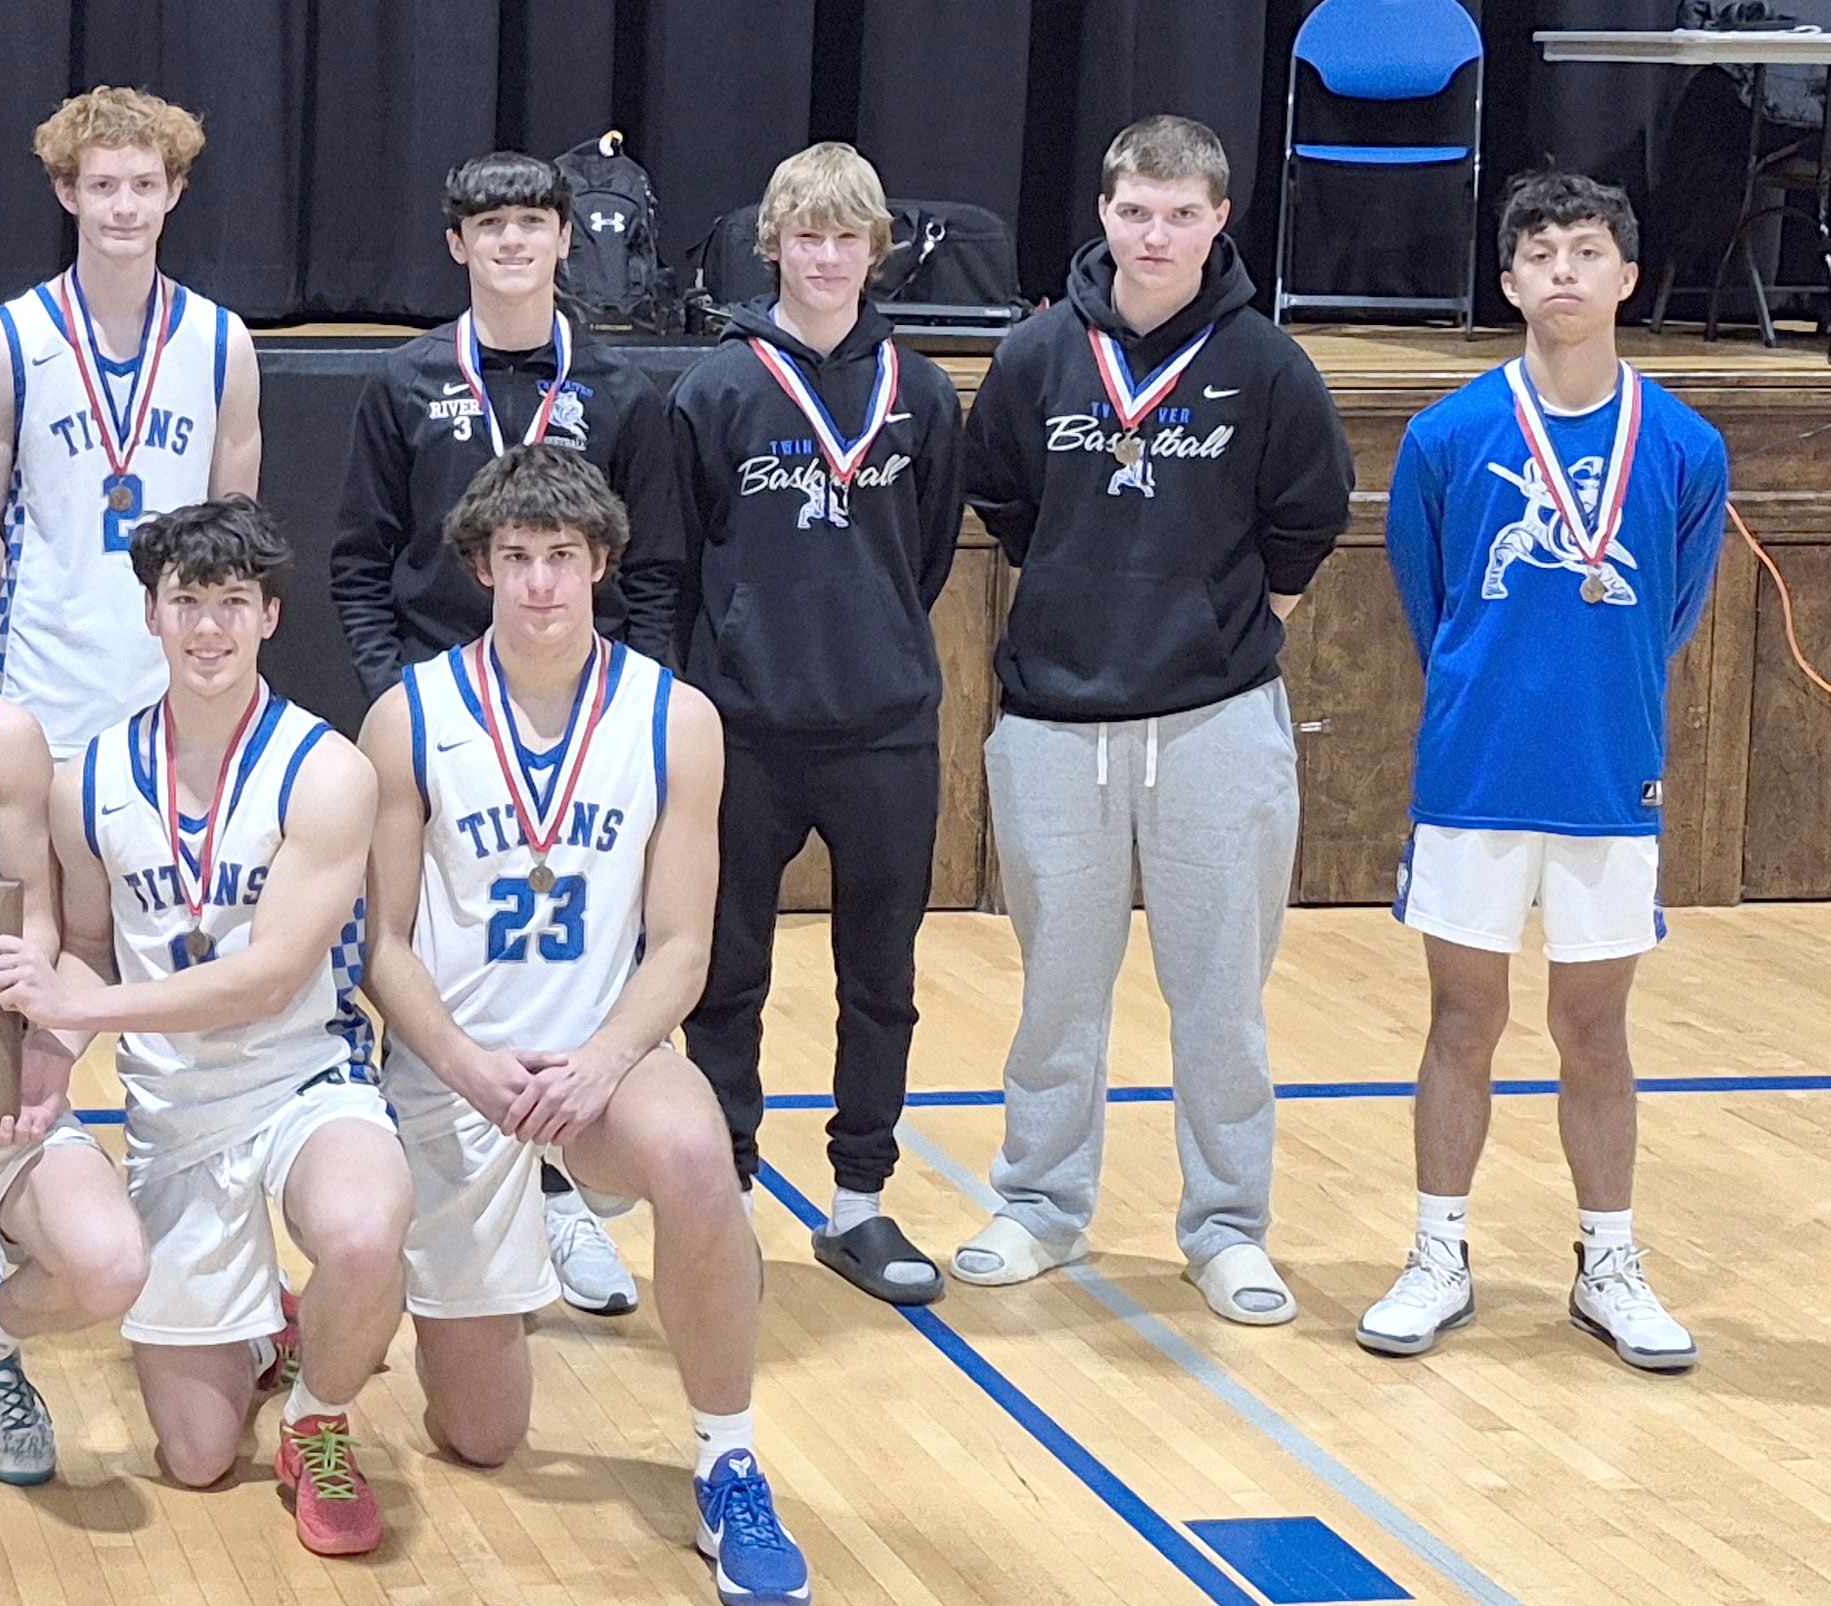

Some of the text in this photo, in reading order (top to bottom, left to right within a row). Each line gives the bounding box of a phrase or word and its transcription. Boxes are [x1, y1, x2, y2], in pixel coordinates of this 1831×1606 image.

[49, 407, 194, 458] TINS
[429, 399, 484, 419] RIVER
[453, 416, 472, 441] 3
[1090, 401, 1191, 423] TW VER
[1046, 414, 1235, 459] Bastball
[737, 453, 911, 497] Baskall
[101, 473, 144, 553] 2
[456, 801, 624, 859] TINS
[122, 860, 268, 913] TITNS
[485, 872, 590, 965] 23
